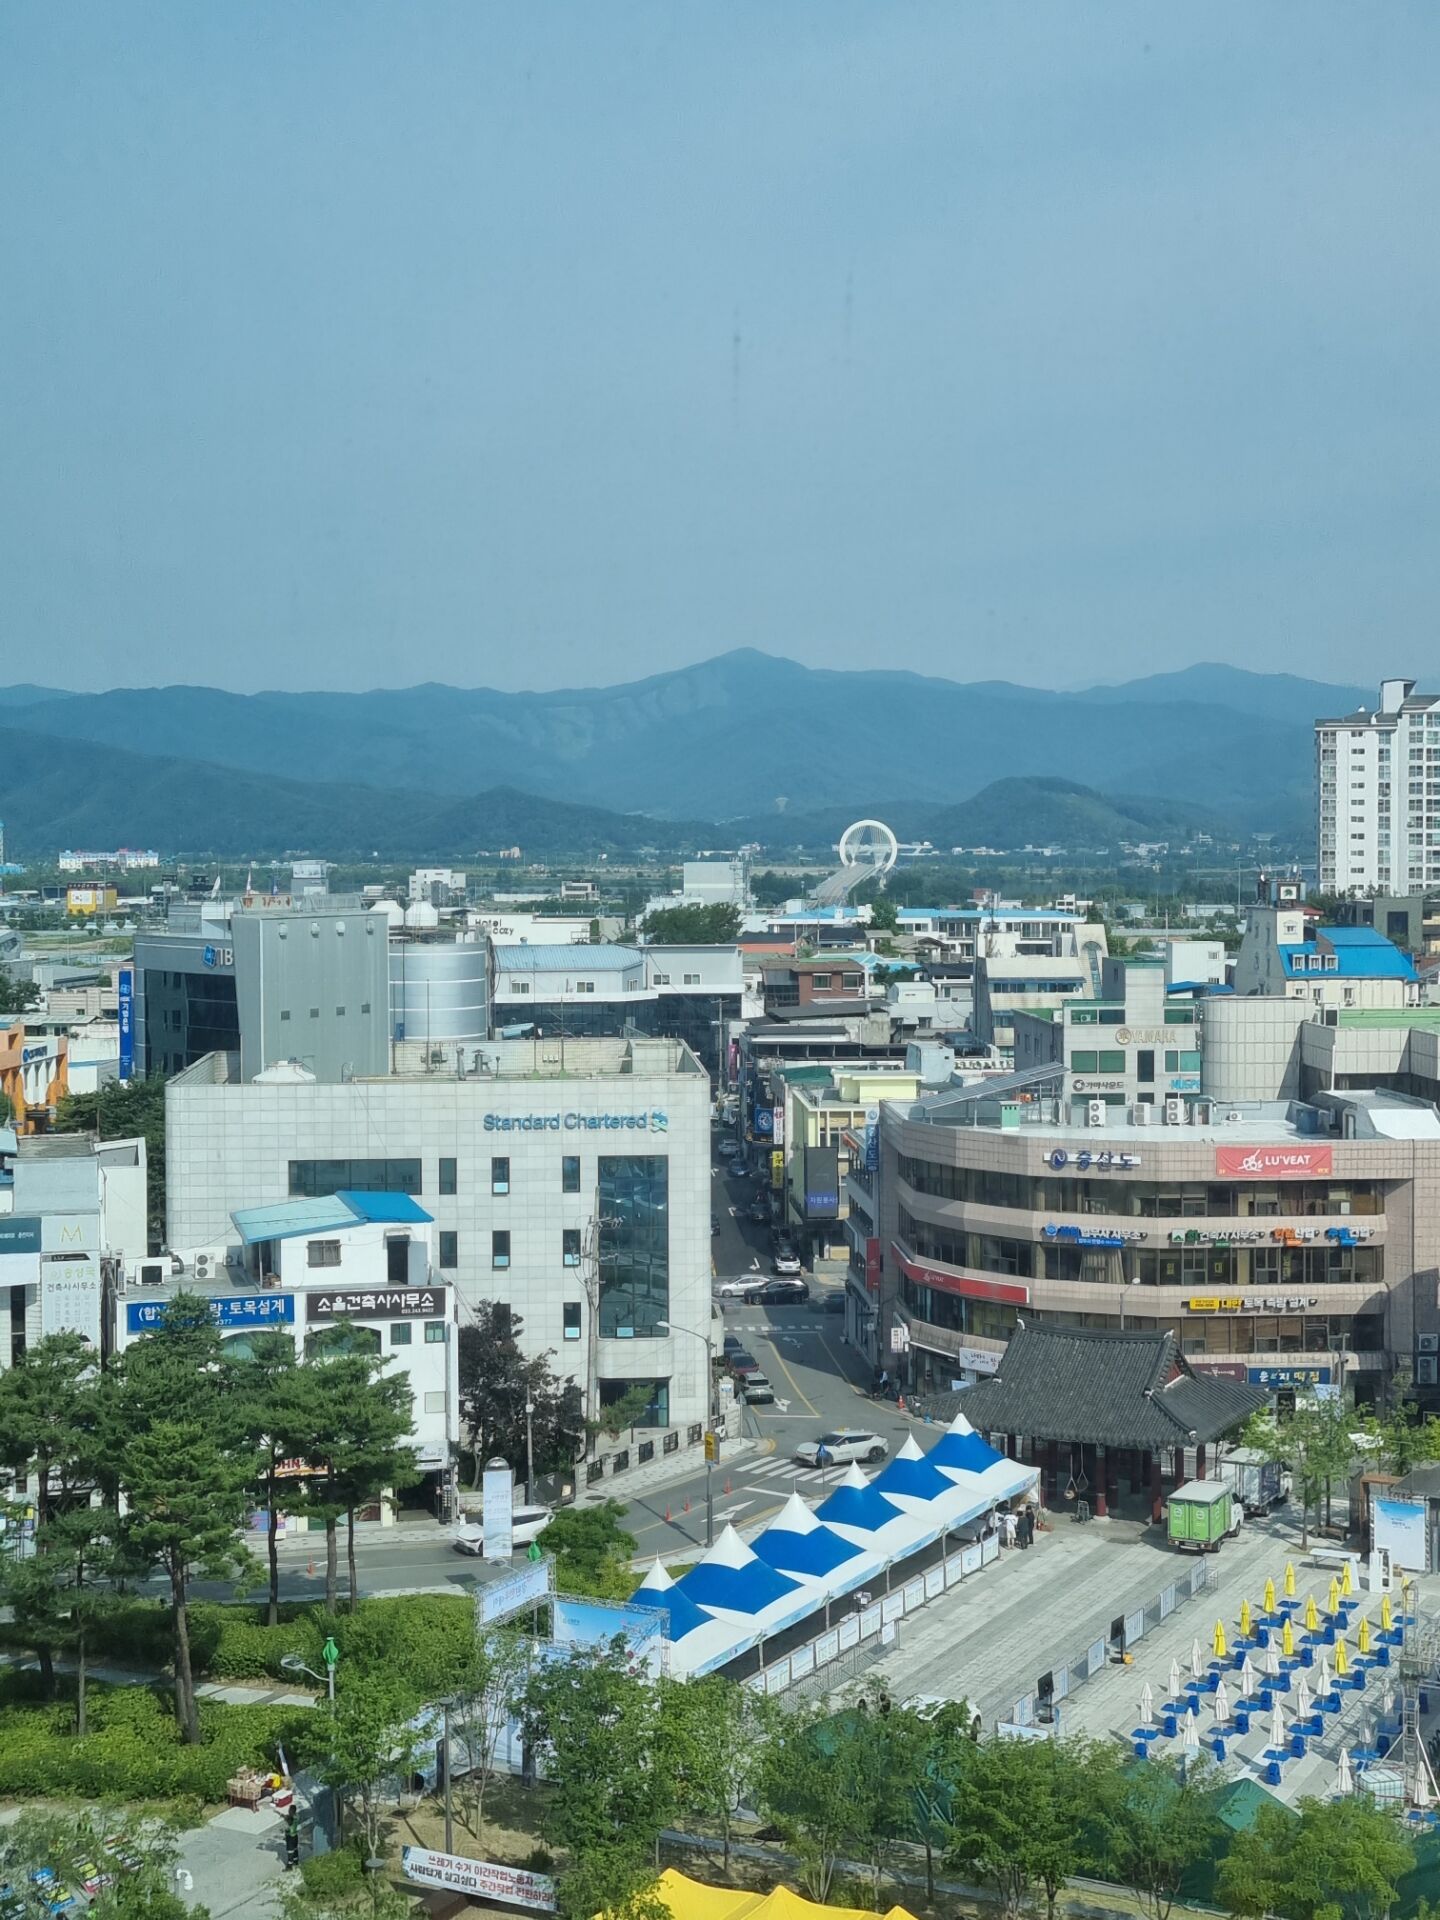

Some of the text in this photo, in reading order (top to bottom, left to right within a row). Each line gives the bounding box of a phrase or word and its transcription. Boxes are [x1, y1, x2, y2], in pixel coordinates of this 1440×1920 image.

[483, 1112, 647, 1132] Standard Chartered
[428, 1855, 453, 1870] 쓰레기
[454, 1862, 472, 1874] 수거
[410, 1863, 443, 1879] 사람답게
[445, 1872, 477, 1888] 살고싶다
